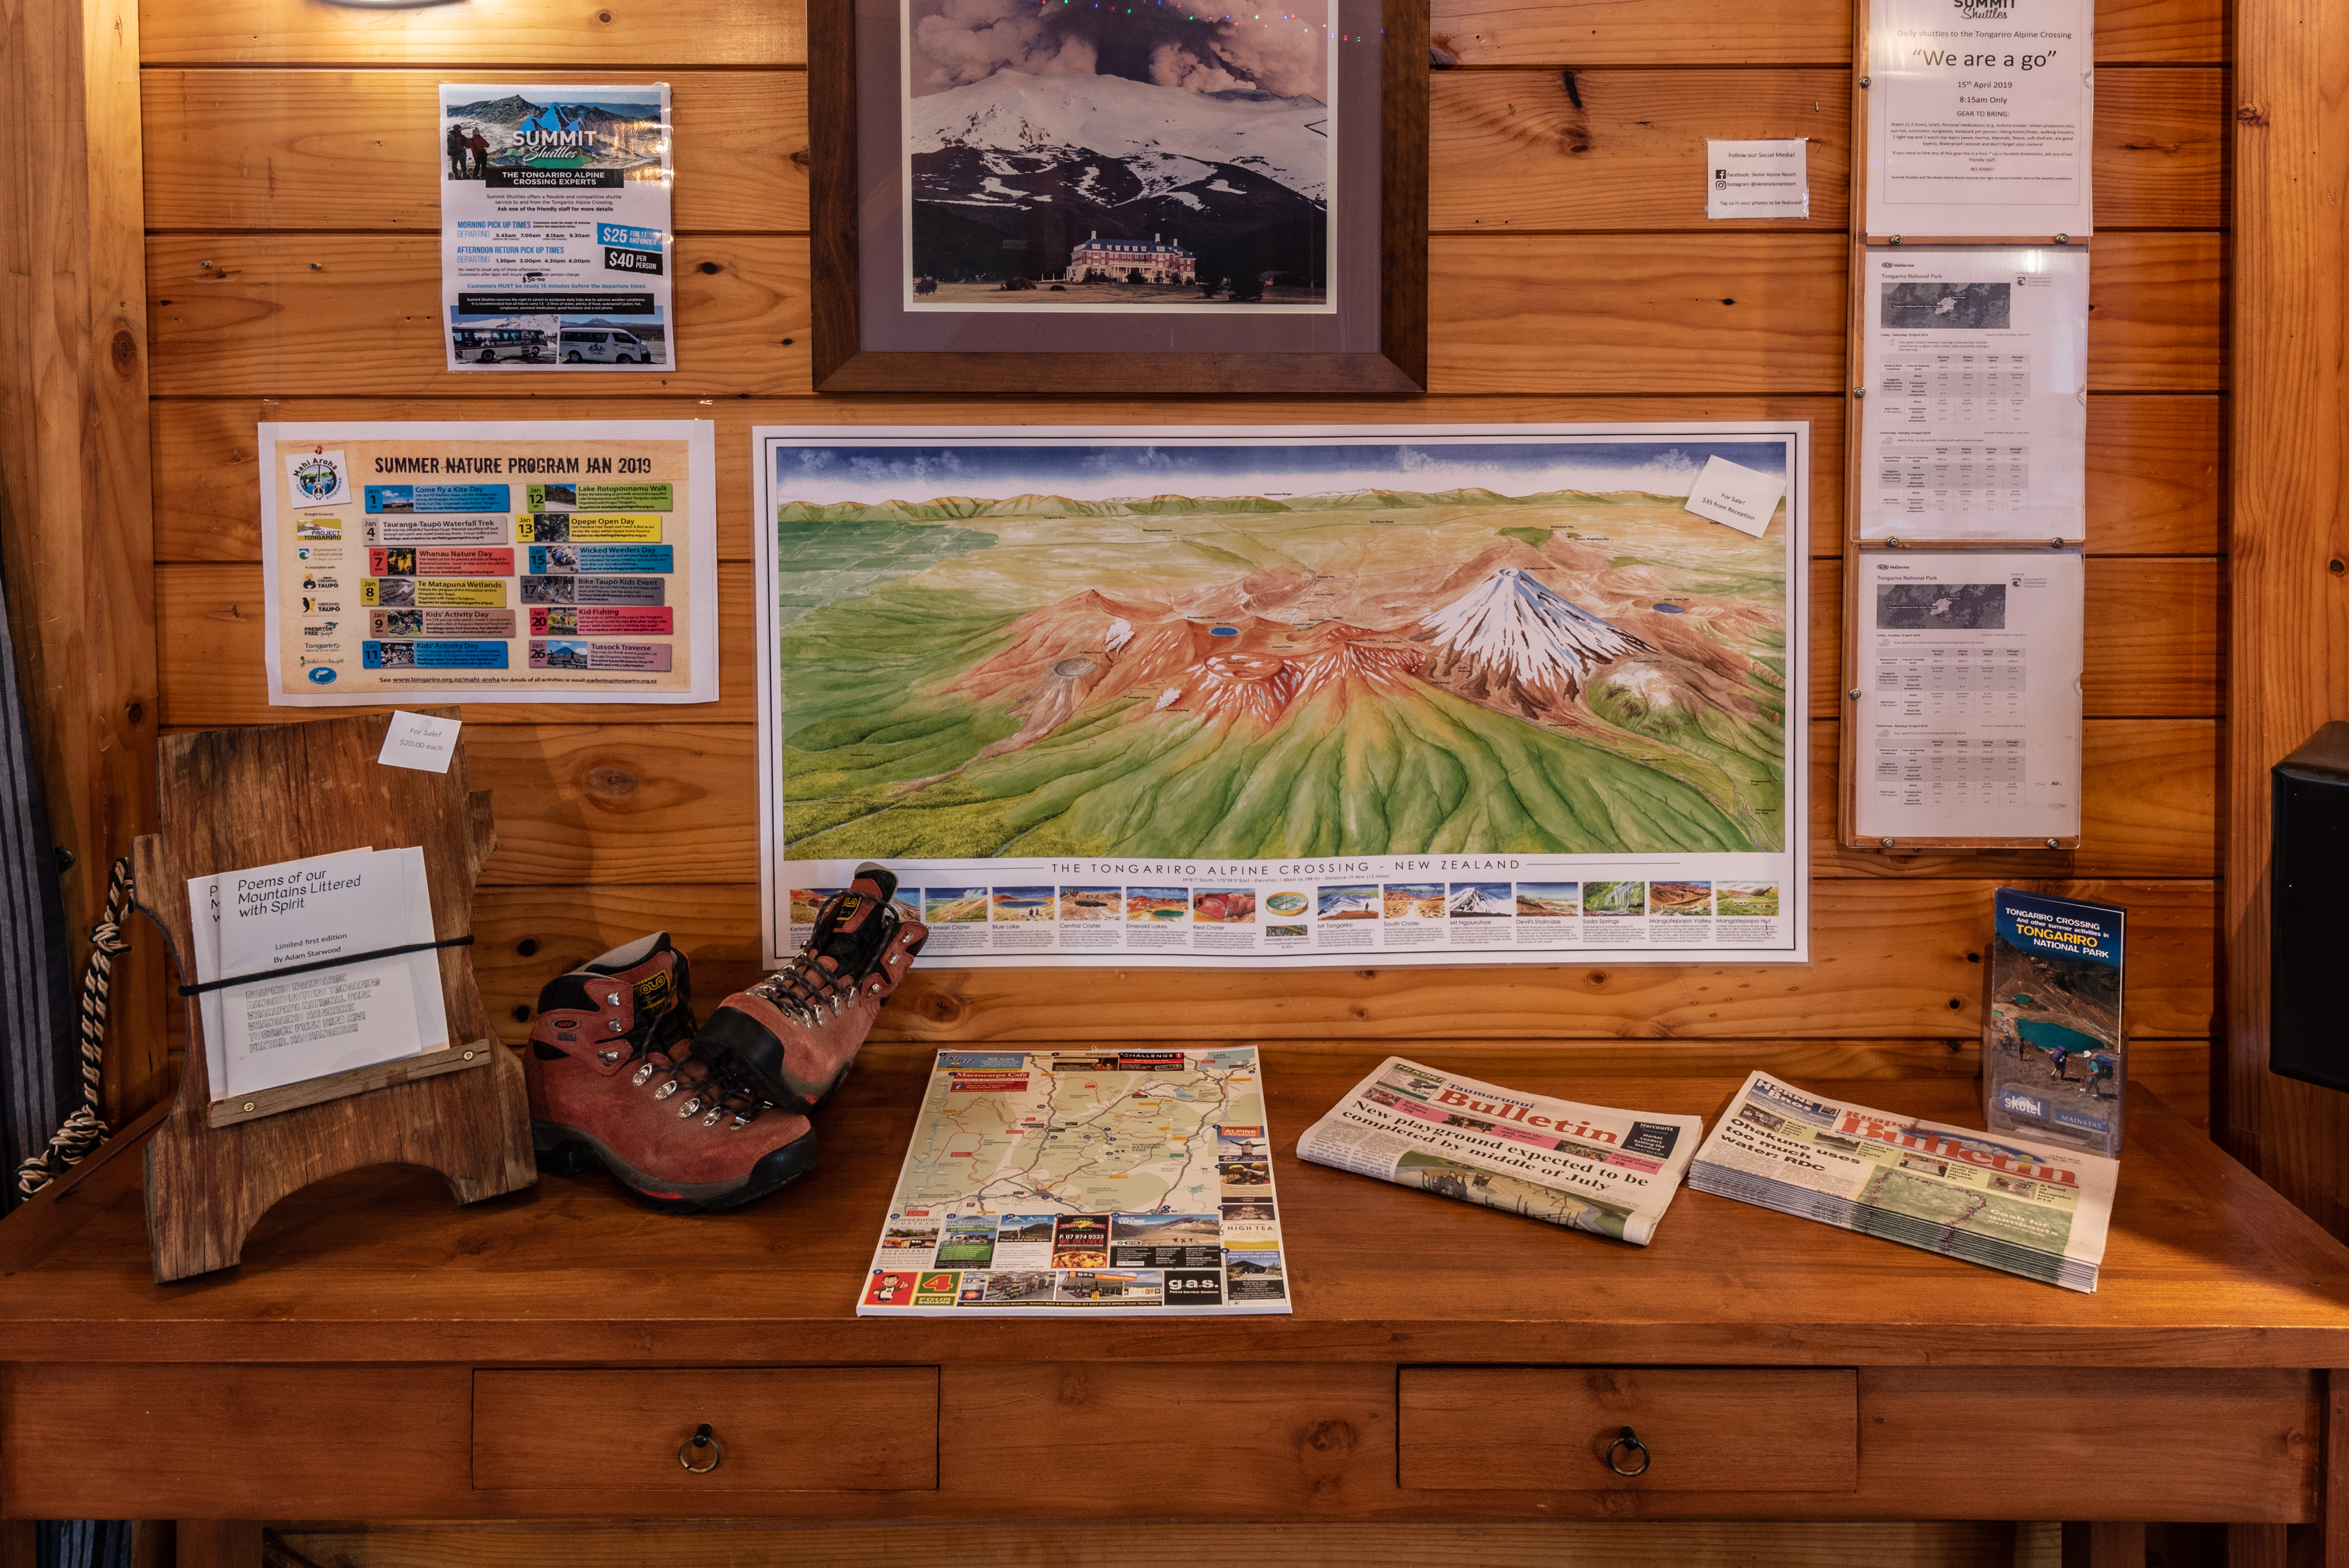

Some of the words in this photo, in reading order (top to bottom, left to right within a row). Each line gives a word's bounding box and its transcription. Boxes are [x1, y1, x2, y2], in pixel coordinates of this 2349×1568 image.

[1960, 7, 2007, 19] Shuttles
[1975, 30, 2011, 39] Tongariro
[2014, 31, 2037, 39] Alpine
[1964, 54, 1996, 66] are
[2003, 55, 2014, 66] a
[512, 131, 596, 146] SUMMIT
[523, 145, 578, 161] Shuttles
[603, 227, 627, 243] $25
[610, 252, 633, 267] $40
[293, 460, 310, 477] Mahi
[313, 458, 337, 470] Aroha
[375, 457, 439, 474] SUMMER
[446, 457, 502, 473] NATURE
[509, 457, 579, 473] PROGRAM
[586, 457, 612, 473] JAN
[619, 457, 651, 473] 2019
[1731, 497, 1745, 505] Sale!
[1713, 502, 1727, 510] from
[1727, 507, 1755, 520] Reception
[423, 729, 441, 738] Sale!
[399, 739, 425, 750] $20.00
[426, 743, 443, 752] each
[1052, 864, 1080, 873] THE
[1091, 864, 1196, 874] TONGARIRO
[1208, 866, 1268, 875] ALPINE
[1279, 862, 1369, 875] CROSSING
[1395, 861, 1430, 870] NEW
[1441, 860, 1520, 870] ZEALAND
[238, 874, 284, 891] Poems
[288, 871, 303, 884] of
[306, 870, 326, 881] our
[238, 885, 307, 904] Mountains
[310, 875, 361, 894] Littered
[239, 902, 267, 917] with
[271, 897, 305, 915] Spirit
[2005, 908, 2053, 922] TONGARIRO
[2056, 917, 2100, 930] CROSSING
[2016, 924, 2098, 947] TONGARIRO
[2048, 923, 2071, 931] summer
[2074, 927, 2101, 937] activities
[275, 940, 303, 950] Limited
[321, 933, 347, 943] edition
[2034, 939, 2079, 953] NATIONAL
[2083, 947, 2109, 958] PARK
[285, 952, 305, 960] Adam
[307, 946, 341, 957] Starwood
[1448, 1083, 1535, 1108] Taumarunui
[1756, 1080, 1814, 1106] HORNE
[1768, 1090, 1812, 1111] BROS
[2005, 1096, 2041, 1116] skotel
[1435, 1089, 1617, 1144] Bulletin
[2061, 1115, 2102, 1129] MAINSTAY
[1352, 1100, 1392, 1119] New
[1394, 1117, 1503, 1150] playground
[1508, 1146, 1593, 1173] expected
[1599, 1168, 1618, 1179] to
[1624, 1174, 1648, 1186] be
[1725, 1125, 1754, 1140] too
[1759, 1141, 1811, 1159] much
[1731, 1119, 1811, 1151] Ohakune
[1816, 1149, 1860, 1164] uses
[1835, 1116, 2075, 1183] Bulletin
[1342, 1111, 1436, 1143] completed
[1440, 1138, 1463, 1150] by
[1469, 1147, 1535, 1170] middle
[1566, 1174, 1610, 1191] July
[1721, 1134, 1779, 1159] water:
[1784, 1156, 1825, 1171] RDC
[923, 1275, 953, 1291] 4
